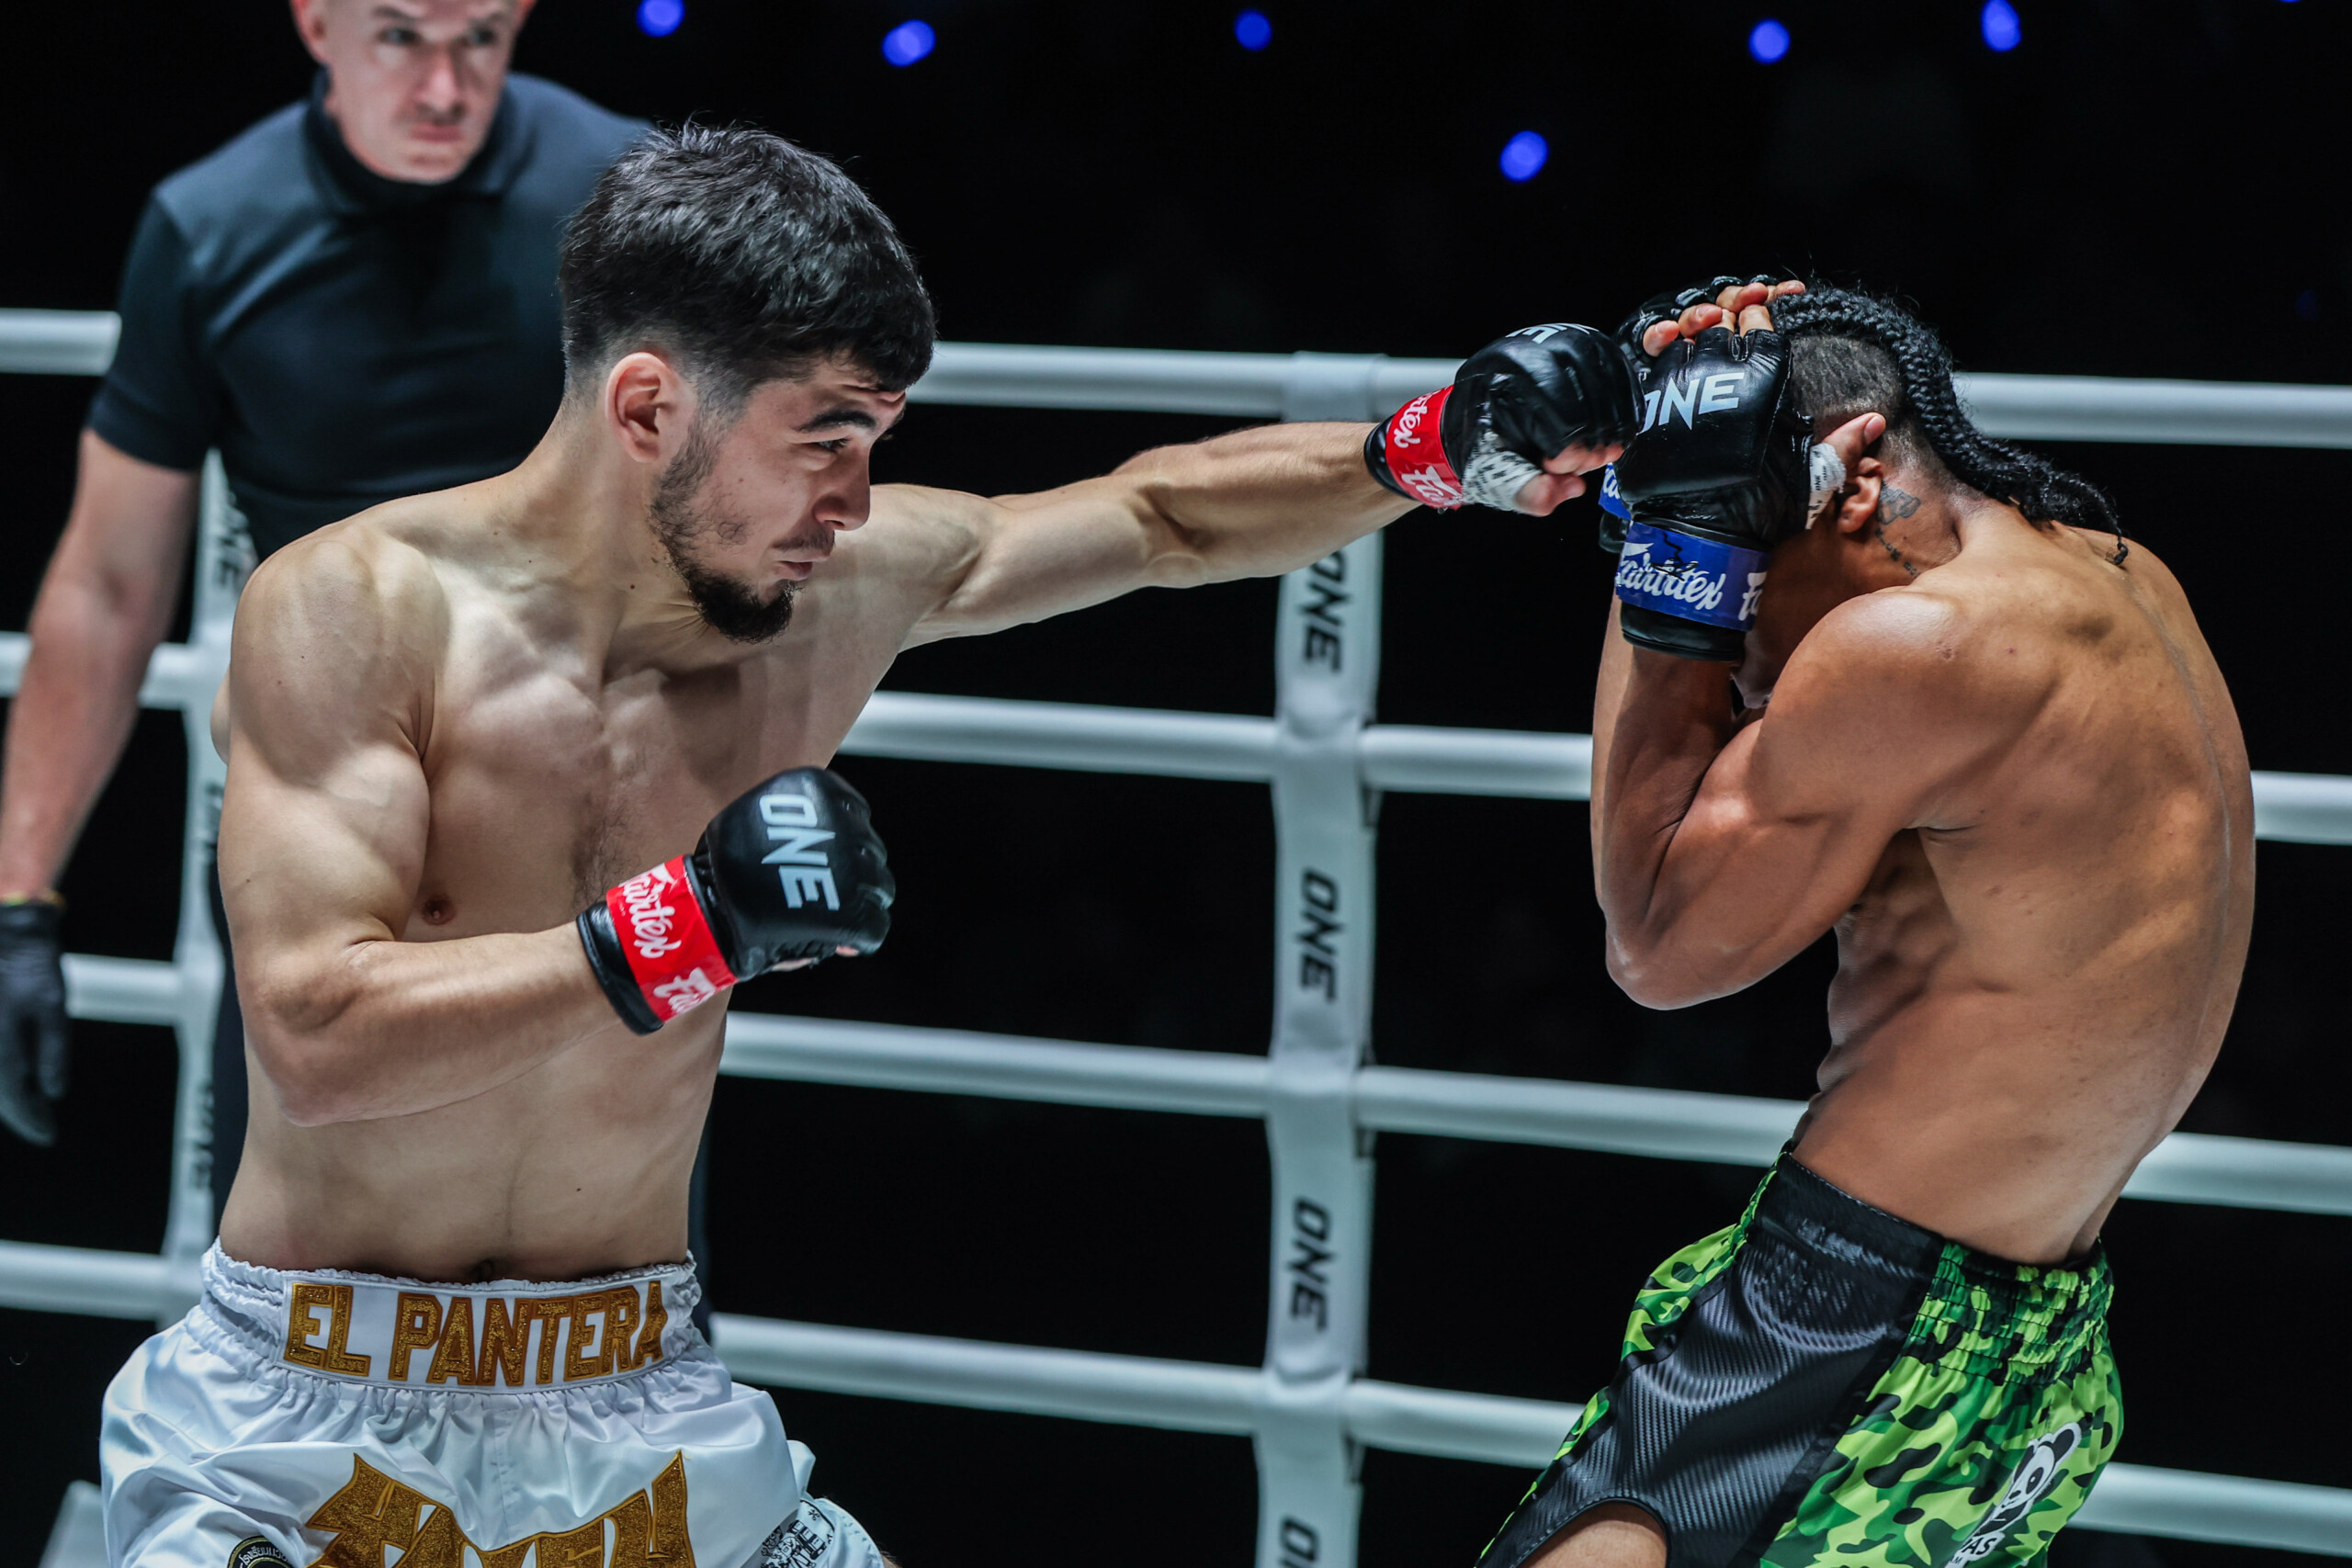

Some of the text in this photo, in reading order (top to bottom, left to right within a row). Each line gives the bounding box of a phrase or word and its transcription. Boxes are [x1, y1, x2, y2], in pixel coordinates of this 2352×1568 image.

[759, 794, 840, 911] ONE
[1295, 866, 1345, 1004] ONE
[1286, 1198, 1336, 1333] ONE
[284, 1280, 668, 1387] EL PANTERA
